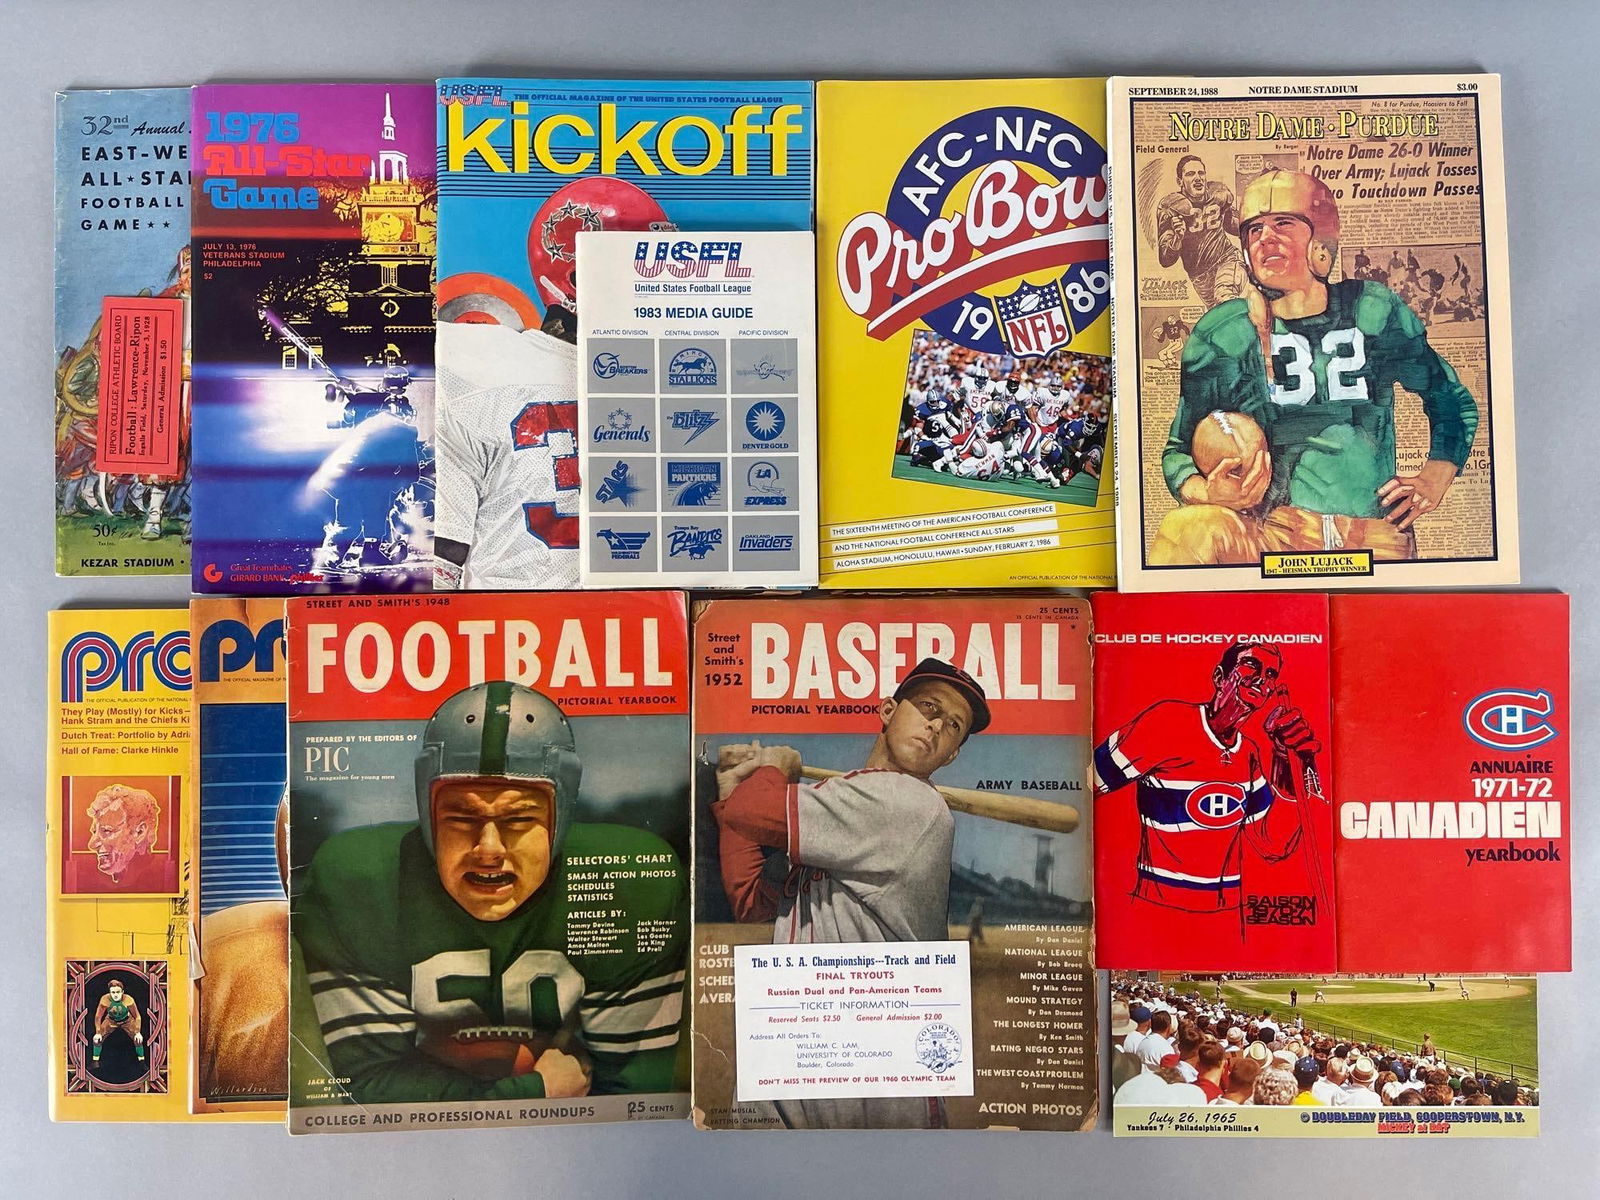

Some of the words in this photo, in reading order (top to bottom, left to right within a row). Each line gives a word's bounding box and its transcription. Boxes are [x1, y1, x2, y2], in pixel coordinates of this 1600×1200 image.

[1188, 88, 1199, 96] 24,
[1249, 86, 1281, 94] NOTRE
[1283, 86, 1312, 94] DAME
[1314, 85, 1358, 93] STADIUM
[1457, 83, 1478, 91] $3.00
[440, 84, 508, 106] USFL
[131, 121, 185, 136] Annual
[206, 111, 299, 143] 1976
[1168, 112, 1251, 142] NOTRE
[1256, 112, 1325, 141] DAME
[1338, 110, 1439, 138] PURDUE
[446, 99, 803, 176] kickoff
[82, 145, 187, 160] EAST-WE
[1136, 145, 1155, 153] Field
[1158, 145, 1189, 153] General
[1307, 144, 1343, 161] Notre
[1348, 144, 1384, 160] Dame
[1388, 142, 1423, 158] 26-0
[1428, 142, 1473, 157] Winner
[202, 145, 371, 177] All-Star
[902, 116, 1083, 216] AFC-NFC
[1311, 165, 1342, 180] Over
[1345, 164, 1385, 181] Army;
[1389, 163, 1430, 180] Lujack
[1436, 162, 1477, 177] Tosses
[81, 172, 122, 186] ALL
[202, 178, 319, 209] Game
[1352, 182, 1427, 199] Touchdown
[1433, 181, 1481, 196] Passes
[81, 197, 184, 208] FOOTBALL
[81, 219, 140, 231] GAME
[837, 211, 962, 315] Pro
[966, 160, 1108, 247] Bow
[633, 241, 752, 278] USFL
[635, 284, 661, 293] United
[663, 284, 687, 293] States
[690, 284, 721, 293] Football
[723, 284, 752, 294] League
[1065, 267, 1110, 313] 86
[634, 308, 661, 319] 1983
[665, 308, 708, 318] MEDIA
[712, 308, 753, 318] GUIDE
[952, 300, 994, 341] 19
[114, 315, 122, 345] BOARD
[1006, 311, 1067, 353] NFL
[112, 349, 121, 387] ATHLETIC
[1270, 328, 1369, 406] 32
[110, 392, 119, 425] COLLEGE
[593, 425, 650, 443] Generals
[110, 430, 118, 454] RIPON
[832, 528, 845, 536] THE
[846, 525, 880, 535] SIXTEENTH
[881, 521, 911, 531] MEETING
[936, 515, 971, 525] AMERICAN
[972, 510, 1007, 521] FOOTBALL
[1008, 505, 1053, 516] CONFERENCE
[739, 537, 792, 548] Invaders
[836, 560, 860, 568] ALOHA
[861, 555, 893, 566] STADIUM,
[894, 551, 935, 562] HONOLULU,
[936, 548, 960, 557] HAWAII
[965, 545, 994, 555] SUNDAY,
[995, 541, 1028, 551] FEBRUARY
[1029, 540, 1035, 548] 2,
[81, 559, 118, 567] KEZAR
[124, 558, 174, 567] STADIUM
[1278, 558, 1308, 568] JOHN
[1311, 556, 1353, 566] LUJACK
[306, 600, 342, 608] STREET
[378, 599, 420, 607] SMITH'S
[426, 598, 450, 606] 1948
[707, 633, 740, 642] Street
[1095, 634, 1136, 643] CLUB
[1141, 634, 1161, 643] DE
[1166, 634, 1233, 643] HOCKEY
[1237, 634, 1323, 643] CANADIEN
[307, 617, 673, 694] FOOTBALL
[713, 645, 734, 654] and
[61, 631, 192, 703] pro
[704, 656, 744, 666] Smith's
[705, 674, 743, 686] 1952
[558, 697, 613, 705] PICTORIAL
[618, 696, 677, 704] YEARBOOK
[61, 709, 82, 717] They
[86, 708, 104, 716] Play
[107, 708, 142, 716] (Mostly)
[752, 705, 810, 714] PICTORIAL
[816, 705, 880, 714] YEARBOOK
[304, 746, 350, 772] PIC
[976, 780, 1013, 790] ARMY
[1021, 780, 1082, 791] BASEBALL
[1471, 778, 1552, 798] 1971-72
[1339, 801, 1561, 840] CANADIEN
[567, 856, 630, 866] SELECTORS'
[636, 854, 672, 864] CHART
[1004, 924, 1047, 932] AMERICAN
[1051, 925, 1084, 933] LEAGUE
[752, 957, 768, 968] The
[773, 957, 781, 967] U.
[786, 957, 794, 967] S.
[799, 957, 808, 967] A.
[914, 955, 930, 965] and
[935, 954, 956, 965] Field
[816, 972, 845, 980] FINAL
[850, 971, 894, 979] TRYOUTS
[800, 1001, 835, 1011] TICKET
[840, 1000, 909, 1010] INFORMATION
[628, 1102, 646, 1113] 25
[979, 1102, 1026, 1114] ACTION
[1032, 1103, 1083, 1116] PHOTOS
[305, 1115, 366, 1127] COLLEGE
[372, 1114, 403, 1124] AND
[409, 1109, 512, 1123] PROFESSIONAL
[519, 1106, 596, 1120] ROUNDUPS
[1148, 1112, 1175, 1126] July
[1178, 1112, 1198, 1123] 26,
[1204, 1112, 1237, 1123] 1965
[1312, 1112, 1376, 1123] DOUBLEDAY
[1379, 1112, 1414, 1123] FIELD,
